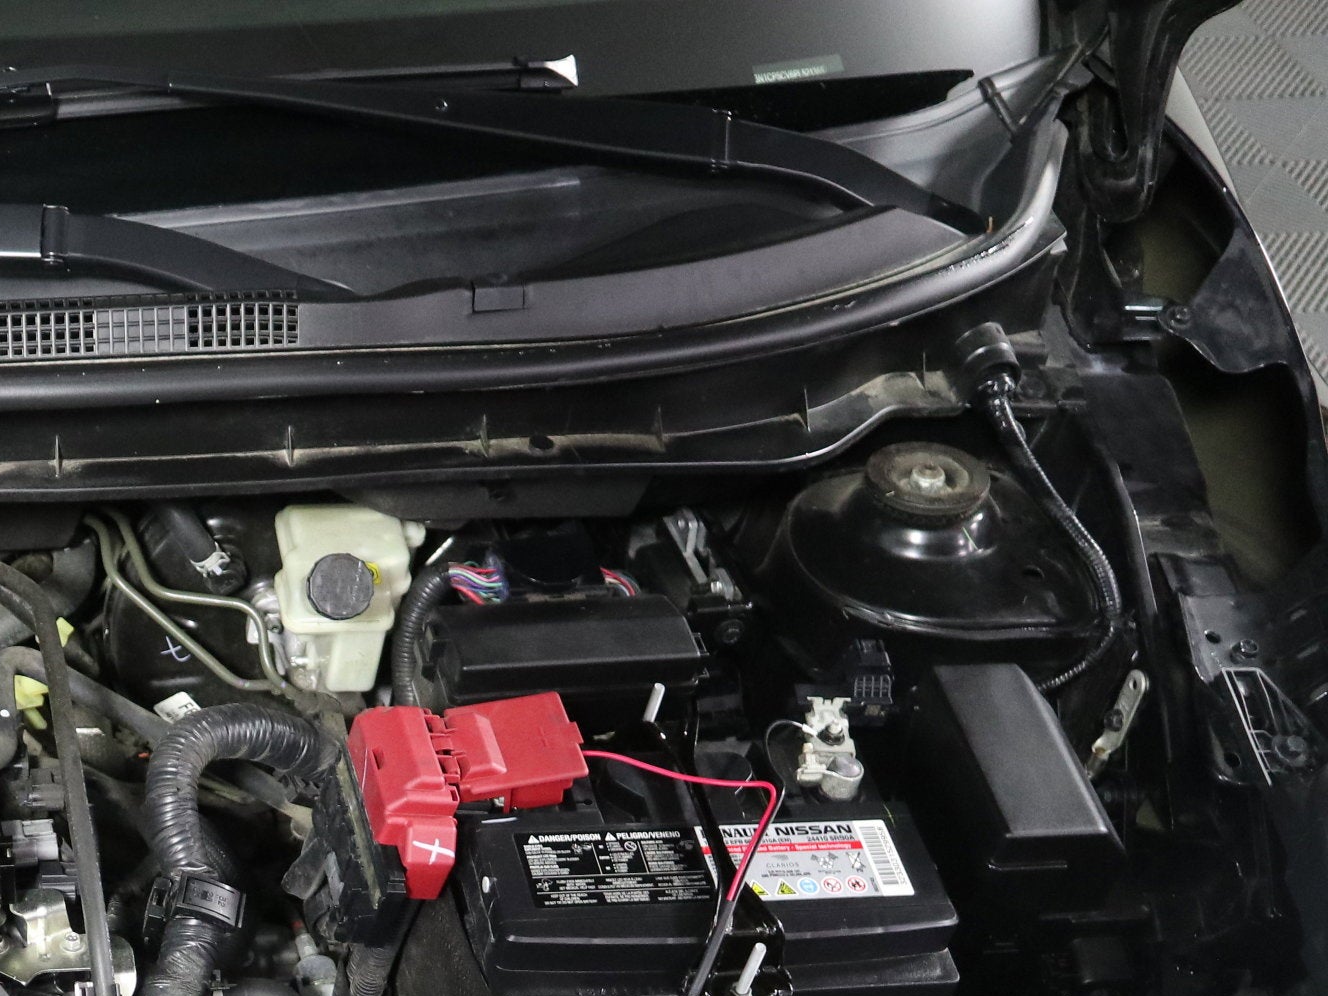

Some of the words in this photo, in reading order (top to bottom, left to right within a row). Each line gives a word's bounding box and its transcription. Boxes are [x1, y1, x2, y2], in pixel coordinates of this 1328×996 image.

[616, 830, 681, 840] PELIGRO/VENENO
[774, 824, 852, 836] NISSAN
[539, 833, 601, 843] DANGER/POISON
